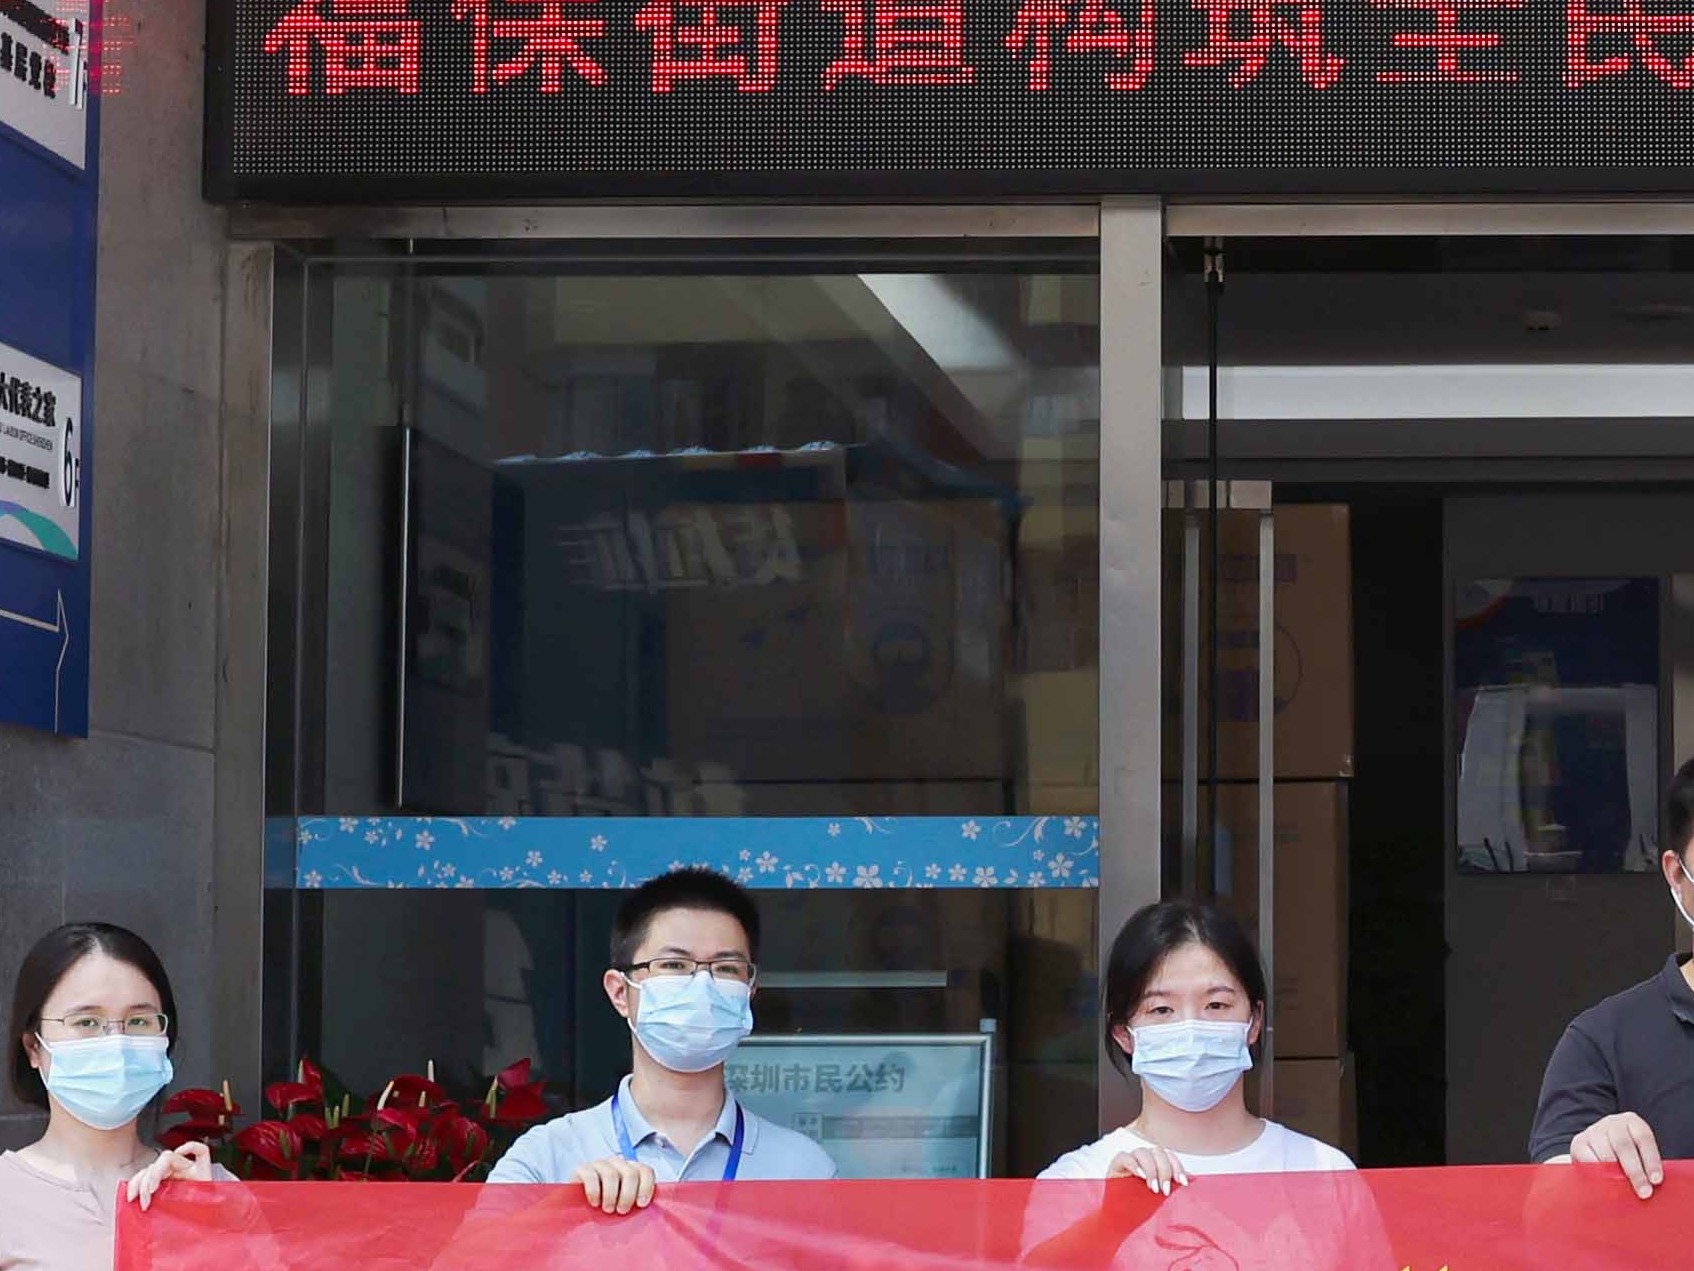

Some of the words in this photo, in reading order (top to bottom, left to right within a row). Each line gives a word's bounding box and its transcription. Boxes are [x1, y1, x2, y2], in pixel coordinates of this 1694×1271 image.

[726, 1064, 906, 1093] 深圳市民公约
